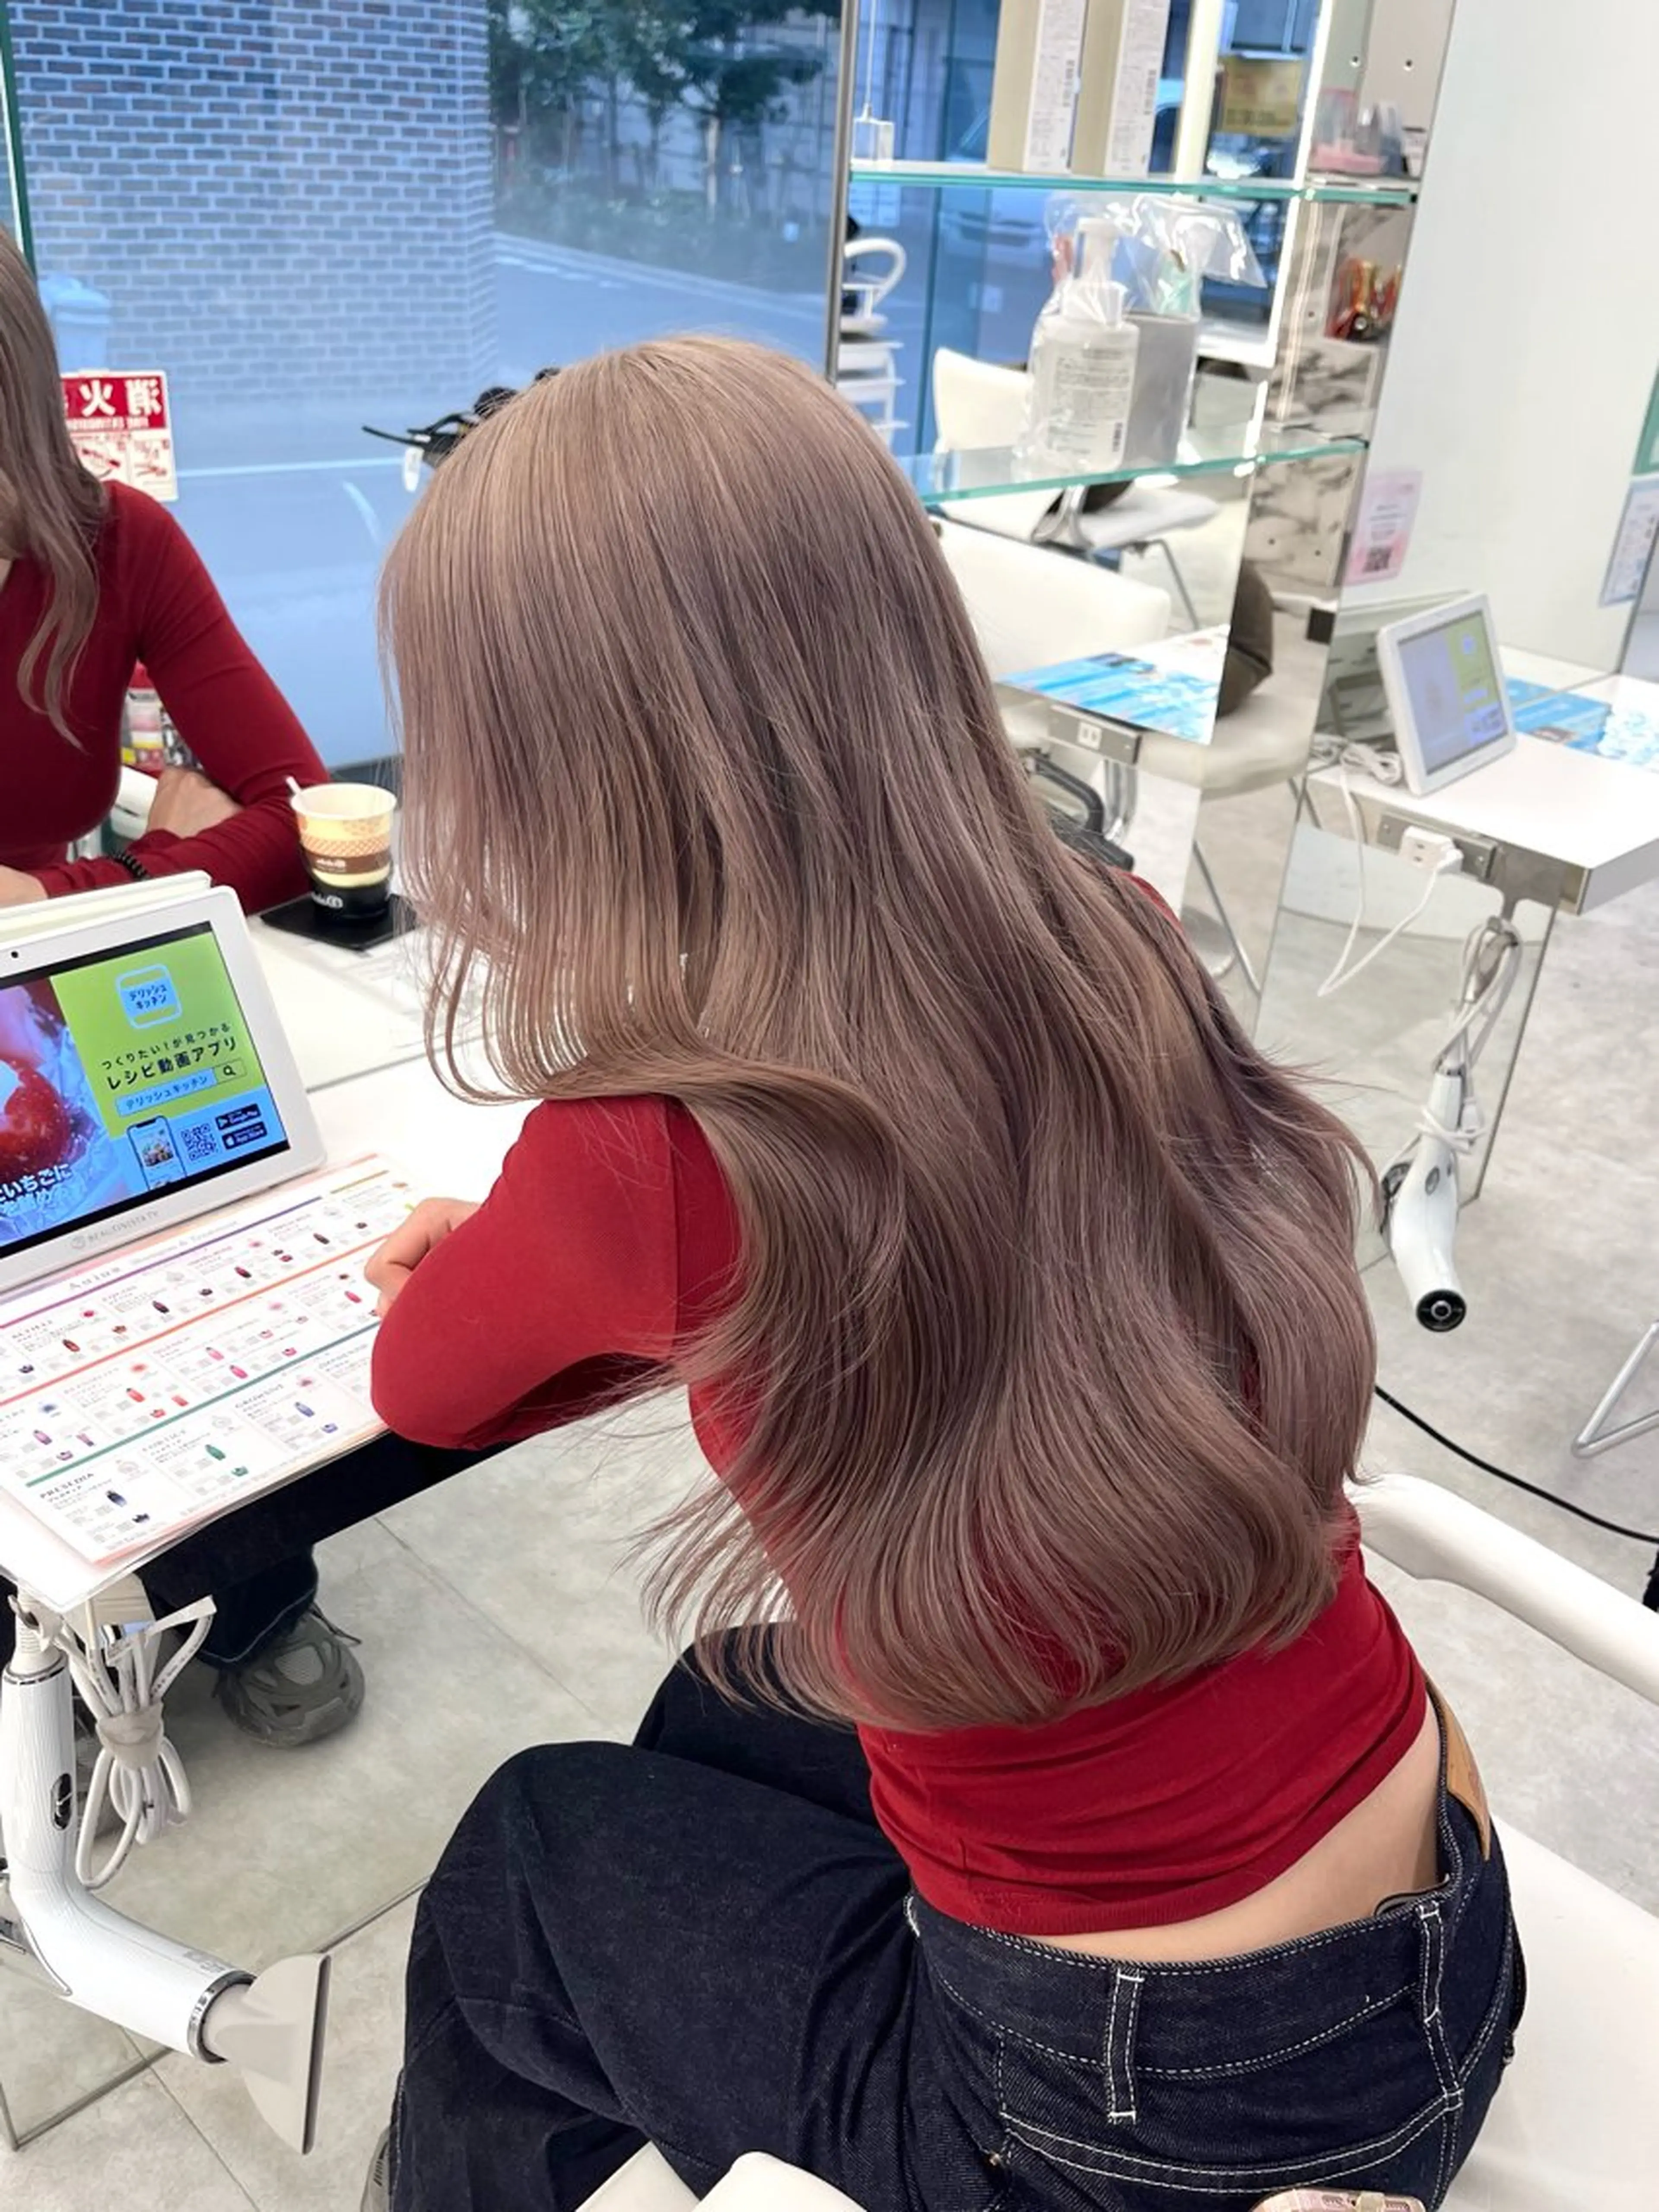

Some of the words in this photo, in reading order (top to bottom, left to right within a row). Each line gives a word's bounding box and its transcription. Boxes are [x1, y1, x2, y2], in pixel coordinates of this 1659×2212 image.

[129, 984, 168, 1002] デリッシュ
[136, 995, 166, 1010] キッチン
[107, 1036, 236, 1090] レシピ動画アプリ
[126, 1075, 208, 1109] デリッシュキッチン
